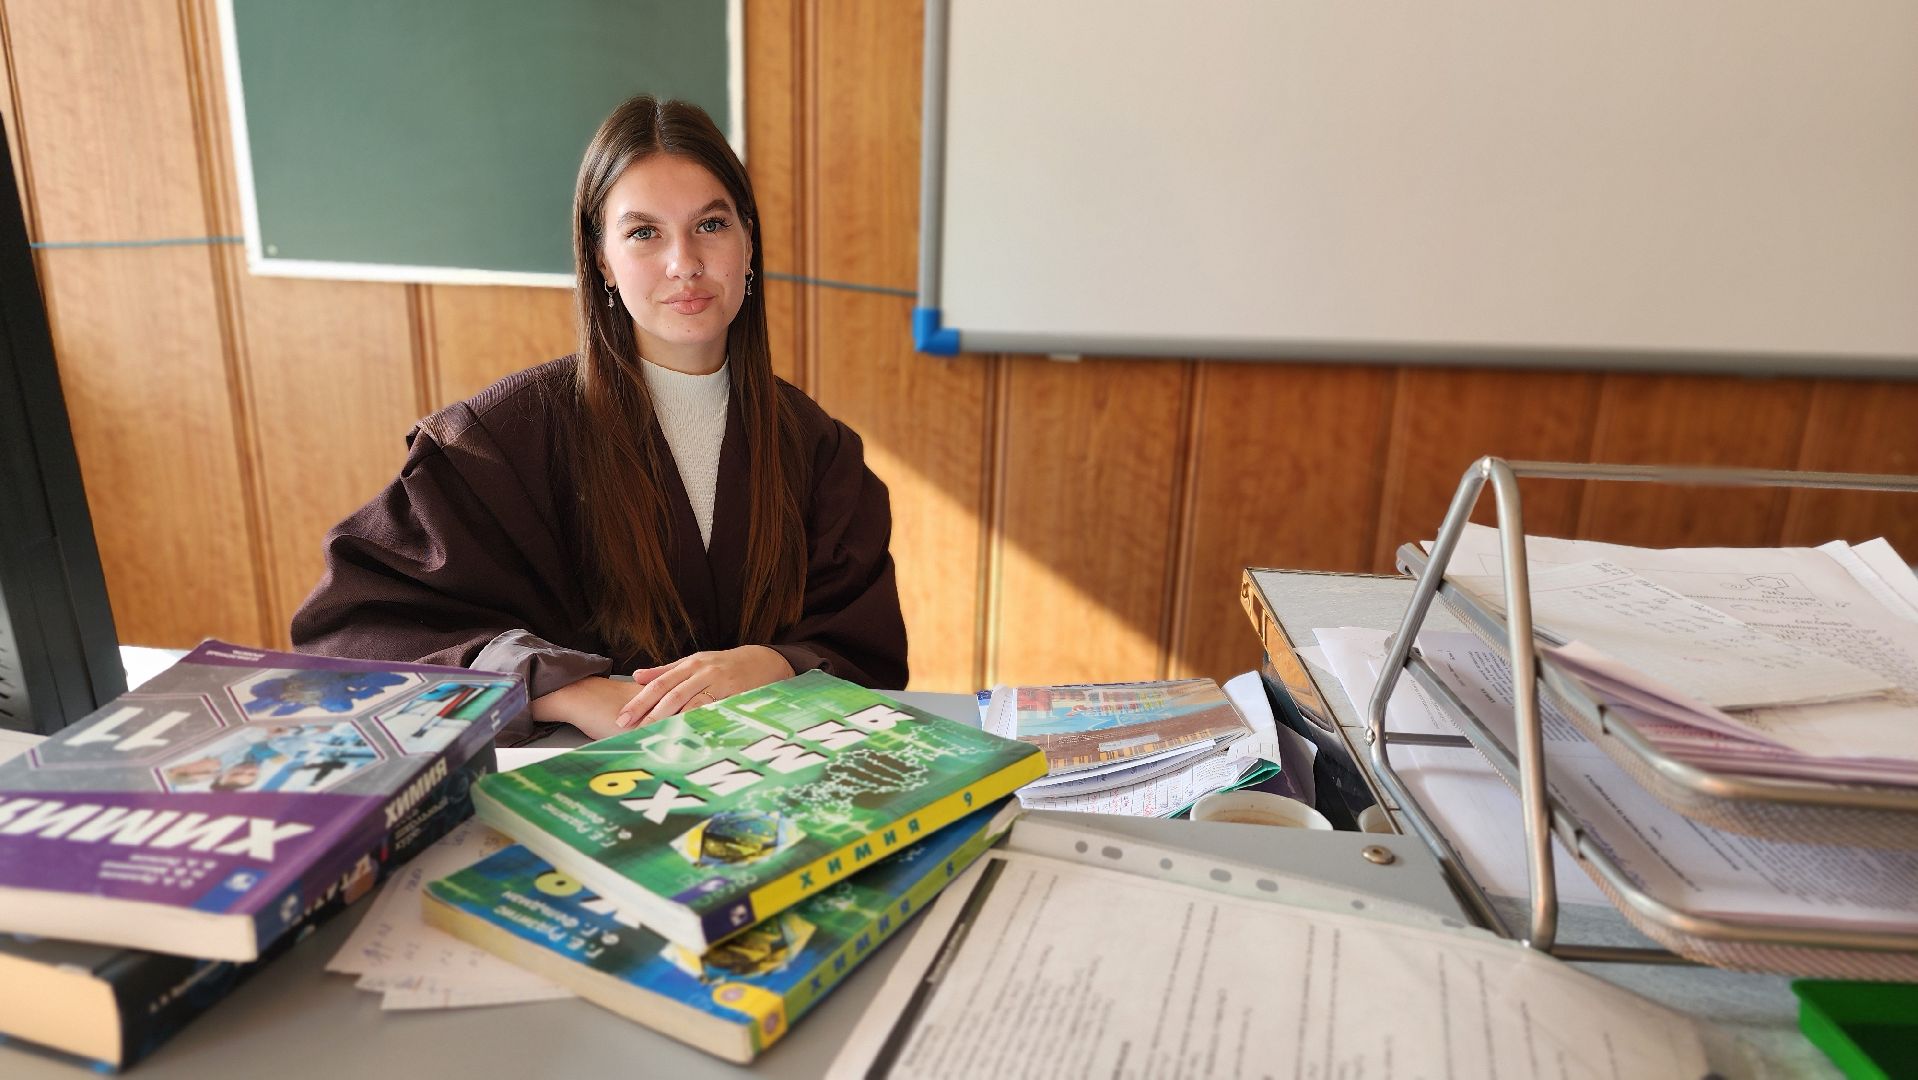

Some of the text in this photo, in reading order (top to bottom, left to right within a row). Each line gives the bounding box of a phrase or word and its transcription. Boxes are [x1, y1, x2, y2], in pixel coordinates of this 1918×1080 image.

[62, 706, 191, 751] 11
[618, 703, 915, 825] ХИМИЯ
[385, 757, 447, 829] ХИМИЯ
[589, 770, 655, 797] 9
[963, 791, 975, 807] 9
[799, 817, 920, 891] ХИМИЯ
[810, 898, 911, 995] ХИМИЯ
